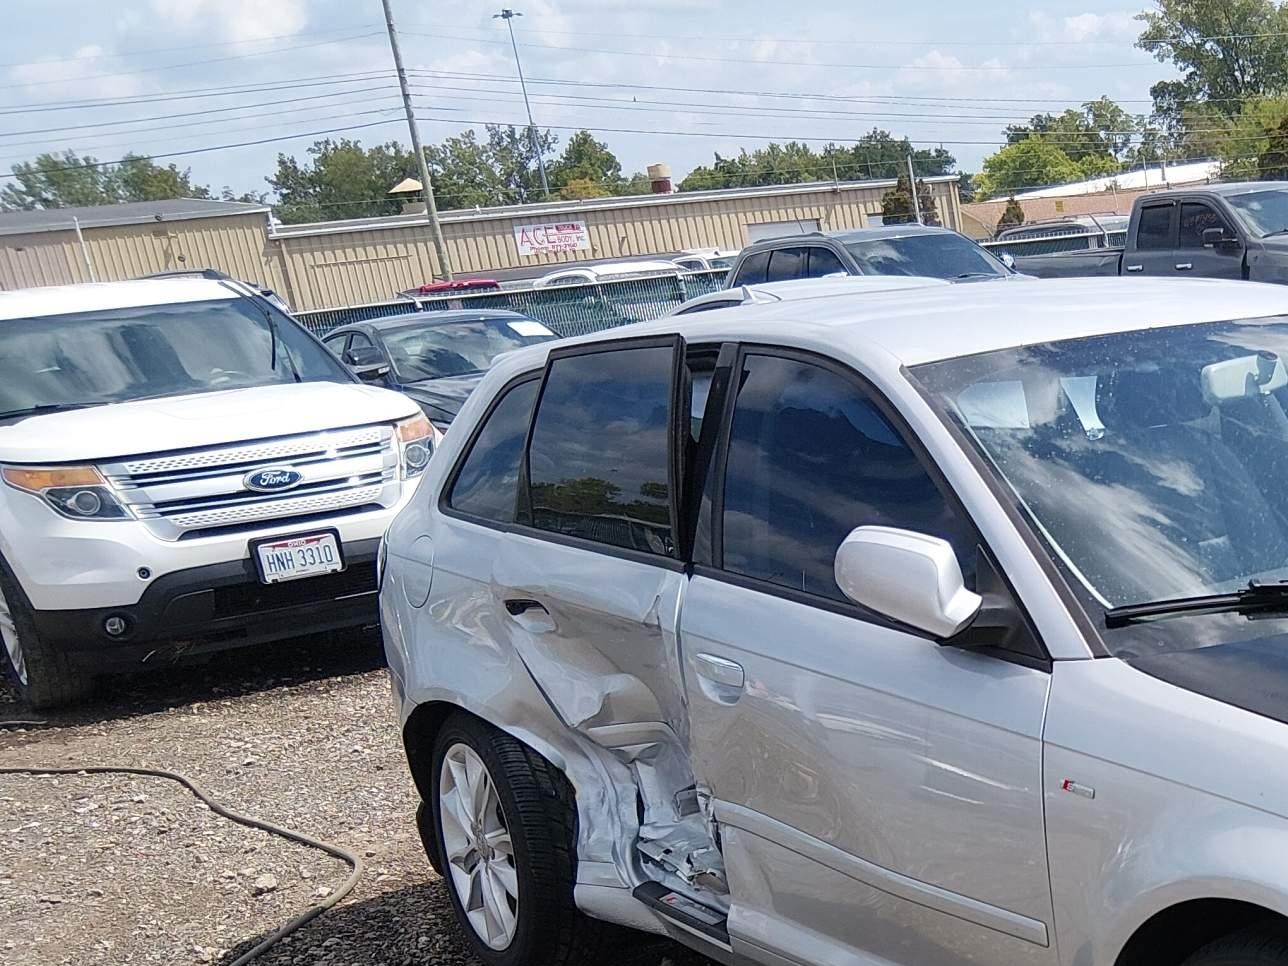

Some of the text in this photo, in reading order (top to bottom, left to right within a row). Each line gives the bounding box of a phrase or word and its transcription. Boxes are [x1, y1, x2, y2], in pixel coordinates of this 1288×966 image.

[520, 224, 557, 246] ACE
[260, 471, 291, 486] Ford
[265, 544, 334, 573] HNH 3310
